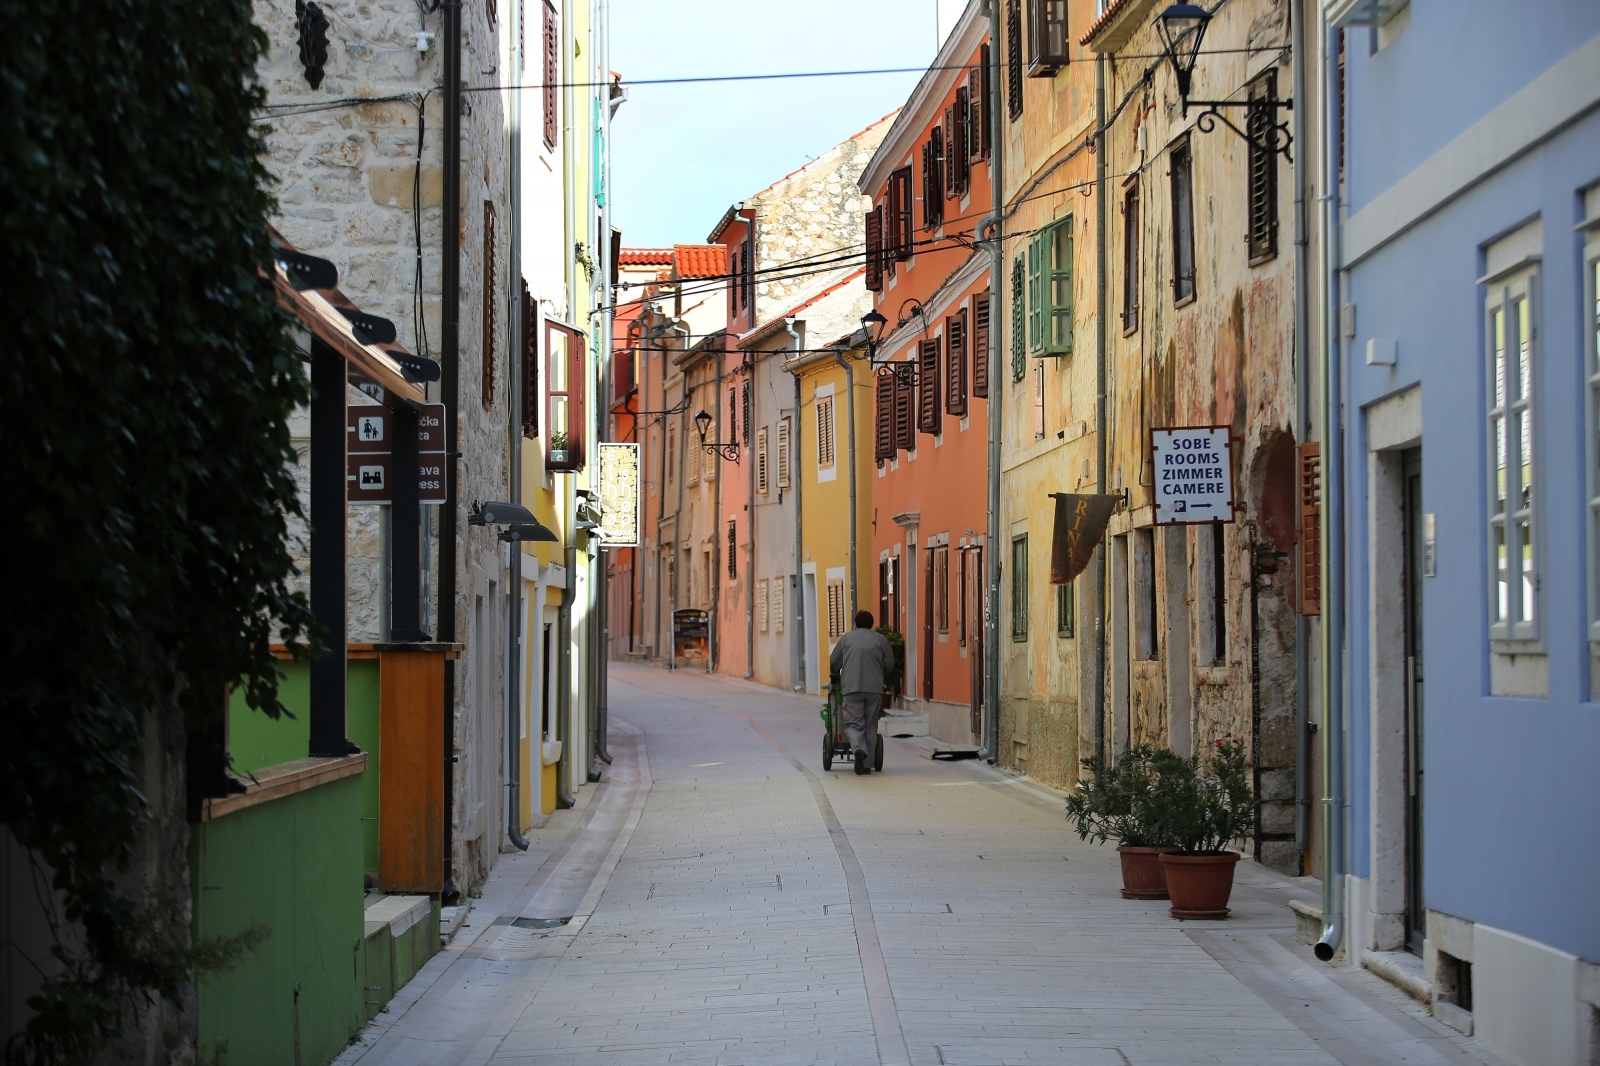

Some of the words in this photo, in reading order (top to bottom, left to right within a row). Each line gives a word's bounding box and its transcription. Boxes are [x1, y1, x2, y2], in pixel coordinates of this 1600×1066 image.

[1172, 438, 1211, 450] SOBE
[1165, 453, 1220, 465] ROOMS
[1162, 468, 1223, 480] ZIMMER
[1162, 482, 1224, 495] CAMERE
